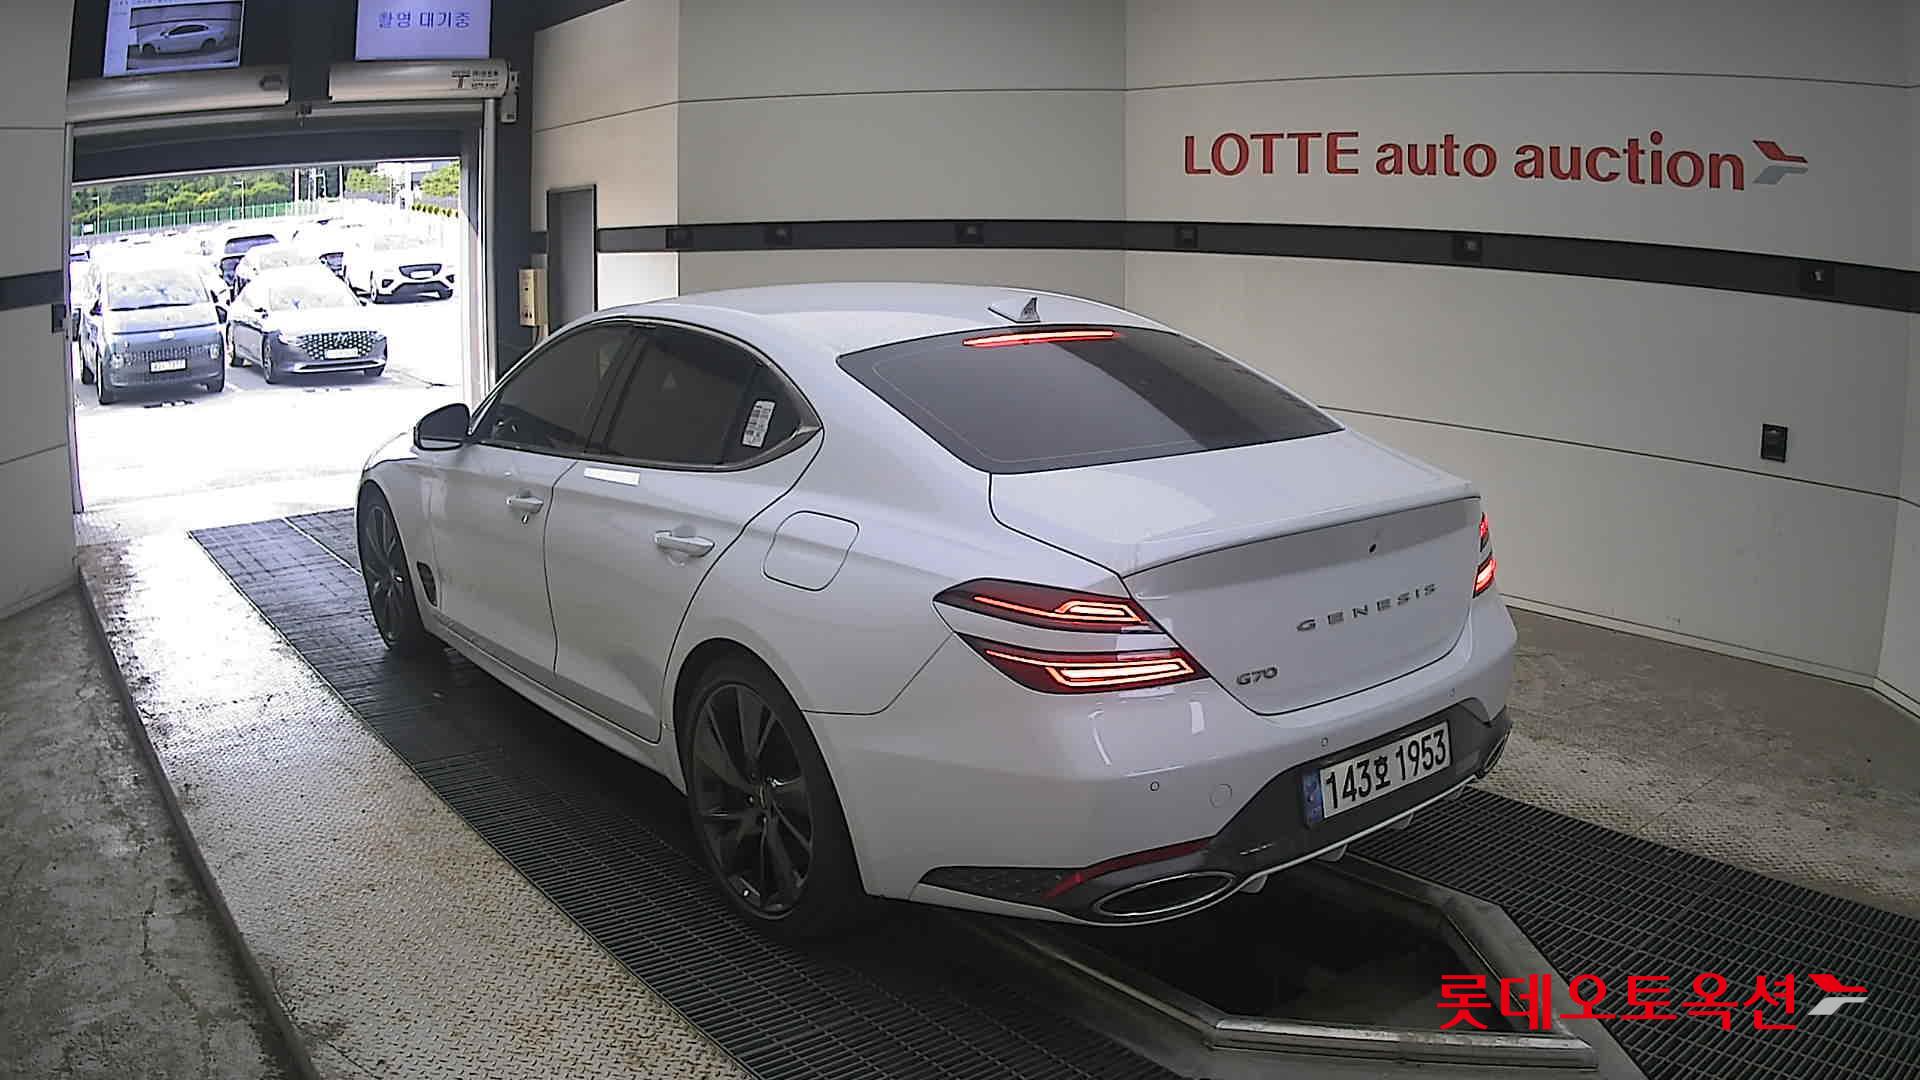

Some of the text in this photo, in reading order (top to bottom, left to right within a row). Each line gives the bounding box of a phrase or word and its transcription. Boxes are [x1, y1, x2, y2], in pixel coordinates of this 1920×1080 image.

[420, 12, 470, 28] 대기중
[1184, 131, 1745, 190] LOTTE auto auction
[1296, 583, 1436, 632] GENESIS
[1236, 666, 1278, 685] G70
[1325, 729, 1447, 809] 143호 1953
